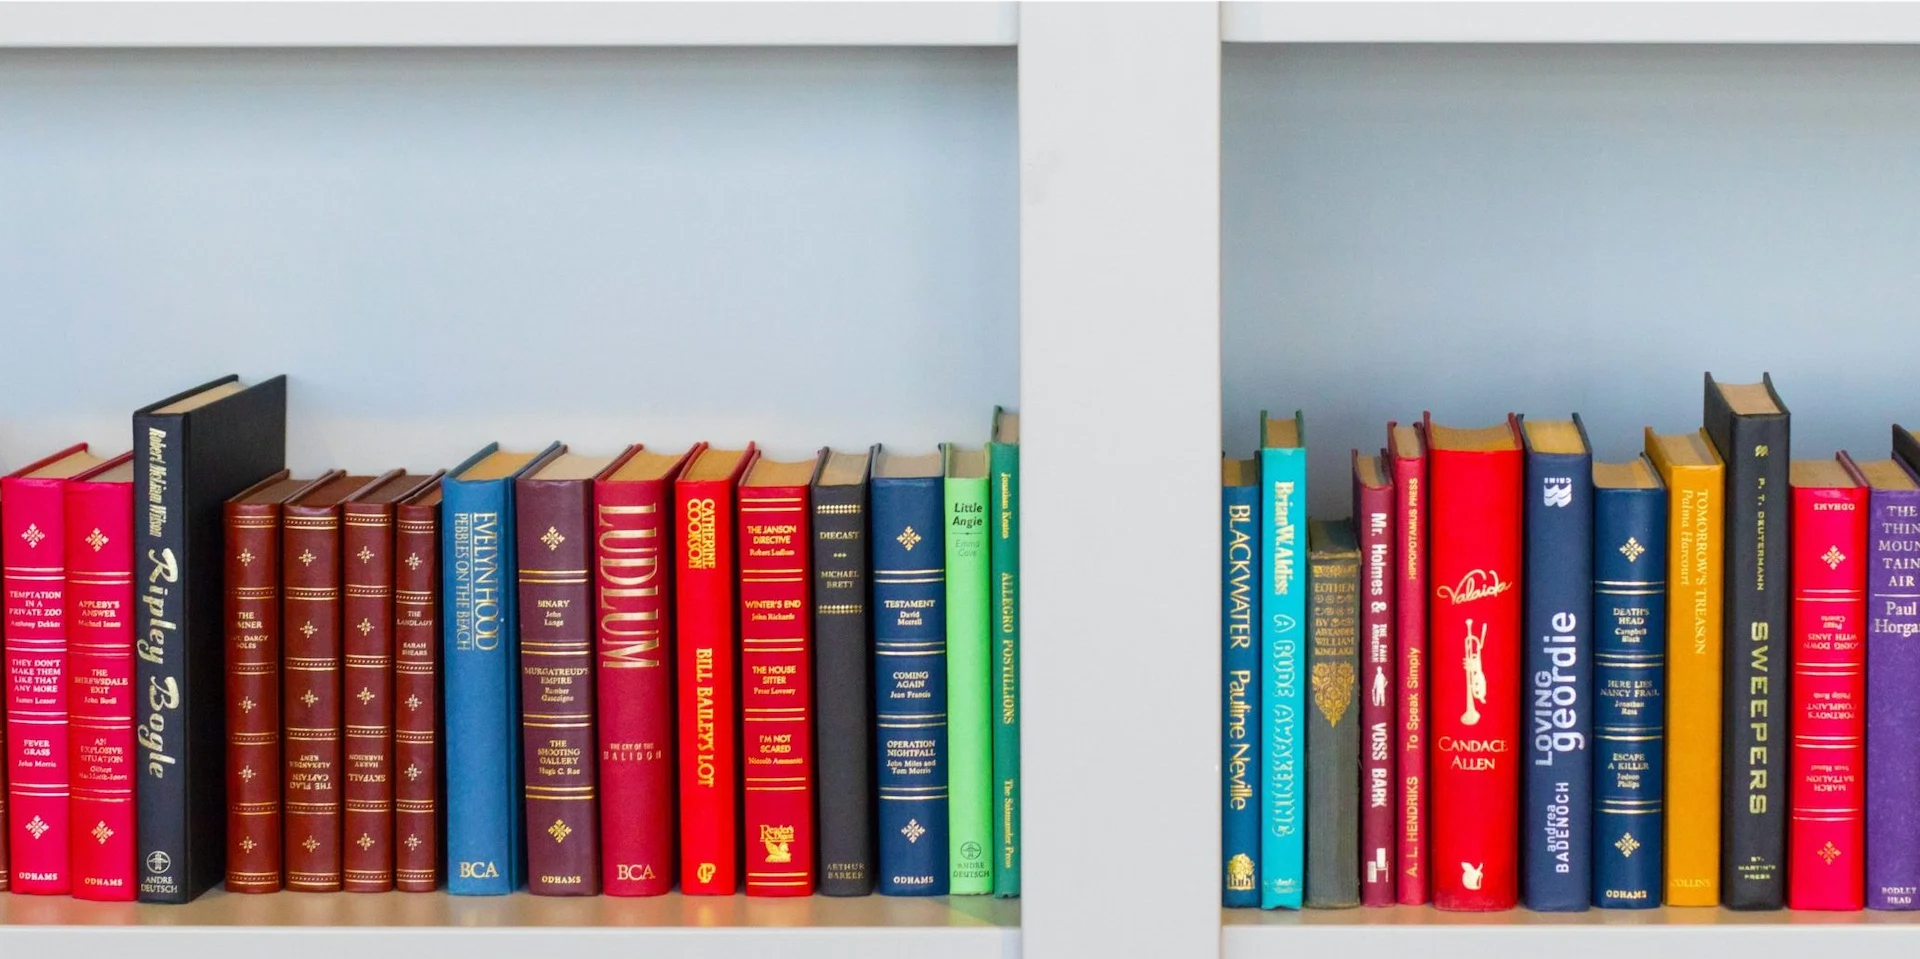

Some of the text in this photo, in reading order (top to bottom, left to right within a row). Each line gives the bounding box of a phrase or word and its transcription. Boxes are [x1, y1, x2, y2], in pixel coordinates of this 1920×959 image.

[149, 427, 166, 463] Robert
[954, 502, 983, 513] Little
[1886, 505, 1917, 517] THE
[149, 504, 166, 537] Wilson
[953, 516, 983, 529] Angie
[687, 498, 702, 569] COOKSON
[702, 498, 715, 569] CATHERINE
[747, 525, 796, 534] THE JANSON
[1408, 478, 1418, 580] HIPPOPOTAMUS PRESS
[753, 536, 791, 544] DIRECTIVE
[820, 531, 860, 540] DIECAST
[1681, 489, 1693, 585] Palma Harcourt
[1371, 513, 1387, 613] Mr. Holmes &
[1229, 504, 1251, 649] BLACKWATER
[1695, 489, 1708, 654] TOMORROW'S TREASON
[455, 513, 470, 650] PEBBLES ON THE BEACH
[474, 512, 499, 651] EVELYN HOOD
[599, 502, 659, 668] LUDLUM
[1889, 576, 1915, 586] AIR
[10, 591, 61, 599] TEMPTATION
[745, 600, 801, 609] WINTER'S END
[884, 600, 935, 608] TESTAMENT
[1886, 602, 1916, 615] Paul
[9, 608, 42, 616] PRIVATE
[1613, 607, 1649, 616] DEATH'S
[1002, 572, 1014, 725] ALLEGRO POSTILLIONS
[12, 659, 32, 667] THEY
[137, 548, 179, 780] Ripley Bogle
[752, 666, 766, 674] THE
[893, 672, 929, 680] COMING
[763, 676, 786, 684] SITTER
[1543, 612, 1585, 752] geordie
[1407, 647, 1421, 751] To Speak Simply
[696, 648, 714, 788] BILL BAILEY'S LOT
[1535, 670, 1553, 766] LOVING
[1750, 621, 1769, 814] SWEEPERS
[887, 740, 935, 749] OPERATION
[1230, 670, 1253, 811] Pauline Neville
[80, 746, 122, 754] EXPLOSIVE
[760, 745, 791, 753] SCARED
[887, 749, 935, 757] NIGHTFALL
[81, 755, 123, 763] SITUATION
[1613, 753, 1644, 761] ESCAPE
[1372, 722, 1387, 808] VOSS BARK
[1618, 761, 1649, 770] KILLER
[349, 774, 386, 782] SKYFALL
[1004, 779, 1014, 797] The
[1407, 776, 1418, 877] A. L. HENDRIKS
[1544, 804, 1556, 852] andrea
[1556, 782, 1569, 873] BADENOCH
[19, 872, 57, 880] ODHAMS
[460, 862, 499, 878] BCA
[617, 865, 655, 880] BCA
[85, 878, 122, 886] ODHAMS
[542, 876, 581, 884] ODHAMS
[893, 876, 933, 884] ODHAMS
[141, 884, 177, 893] DEUTSCH
[1606, 890, 1647, 898] ODHAMS
[1887, 896, 1911, 904] HEAD
